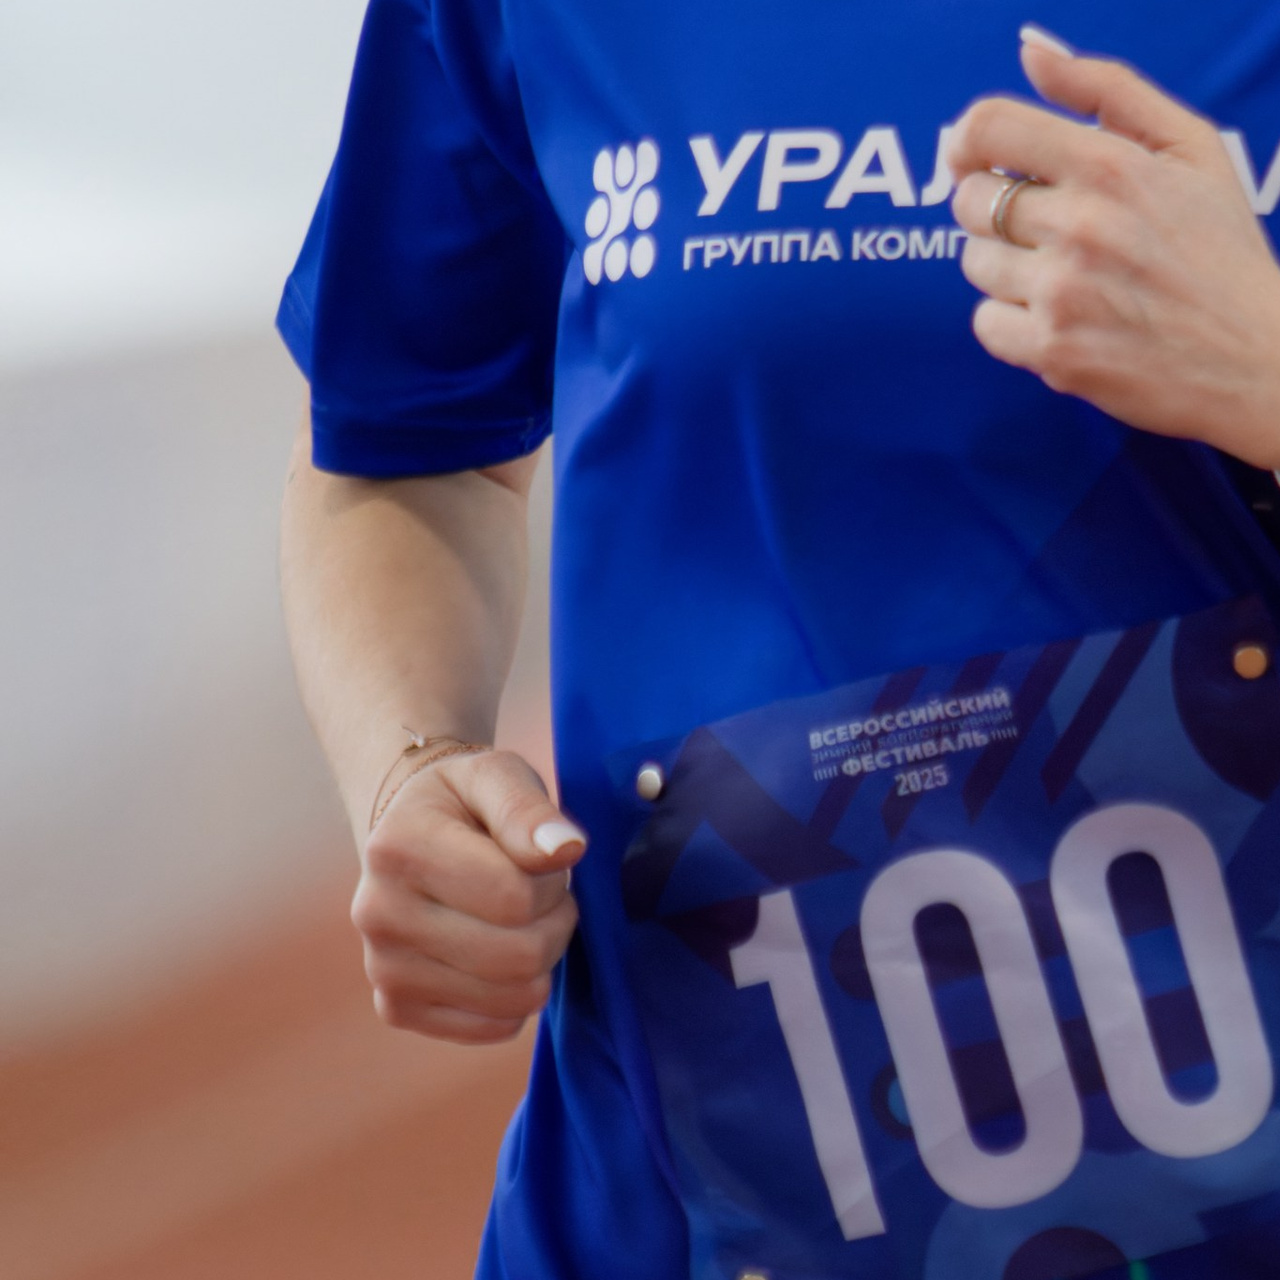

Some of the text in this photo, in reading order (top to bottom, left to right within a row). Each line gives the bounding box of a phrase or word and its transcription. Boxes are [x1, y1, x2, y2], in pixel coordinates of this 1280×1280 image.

[683, 231, 840, 271] ГРУППА
[809, 688, 1011, 749] ВСЕРОССИЙСКИЙ
[841, 731, 989, 777] ФЕСТИВАЛЬ
[895, 764, 949, 797] 2025
[729, 802, 1274, 1242] 100
